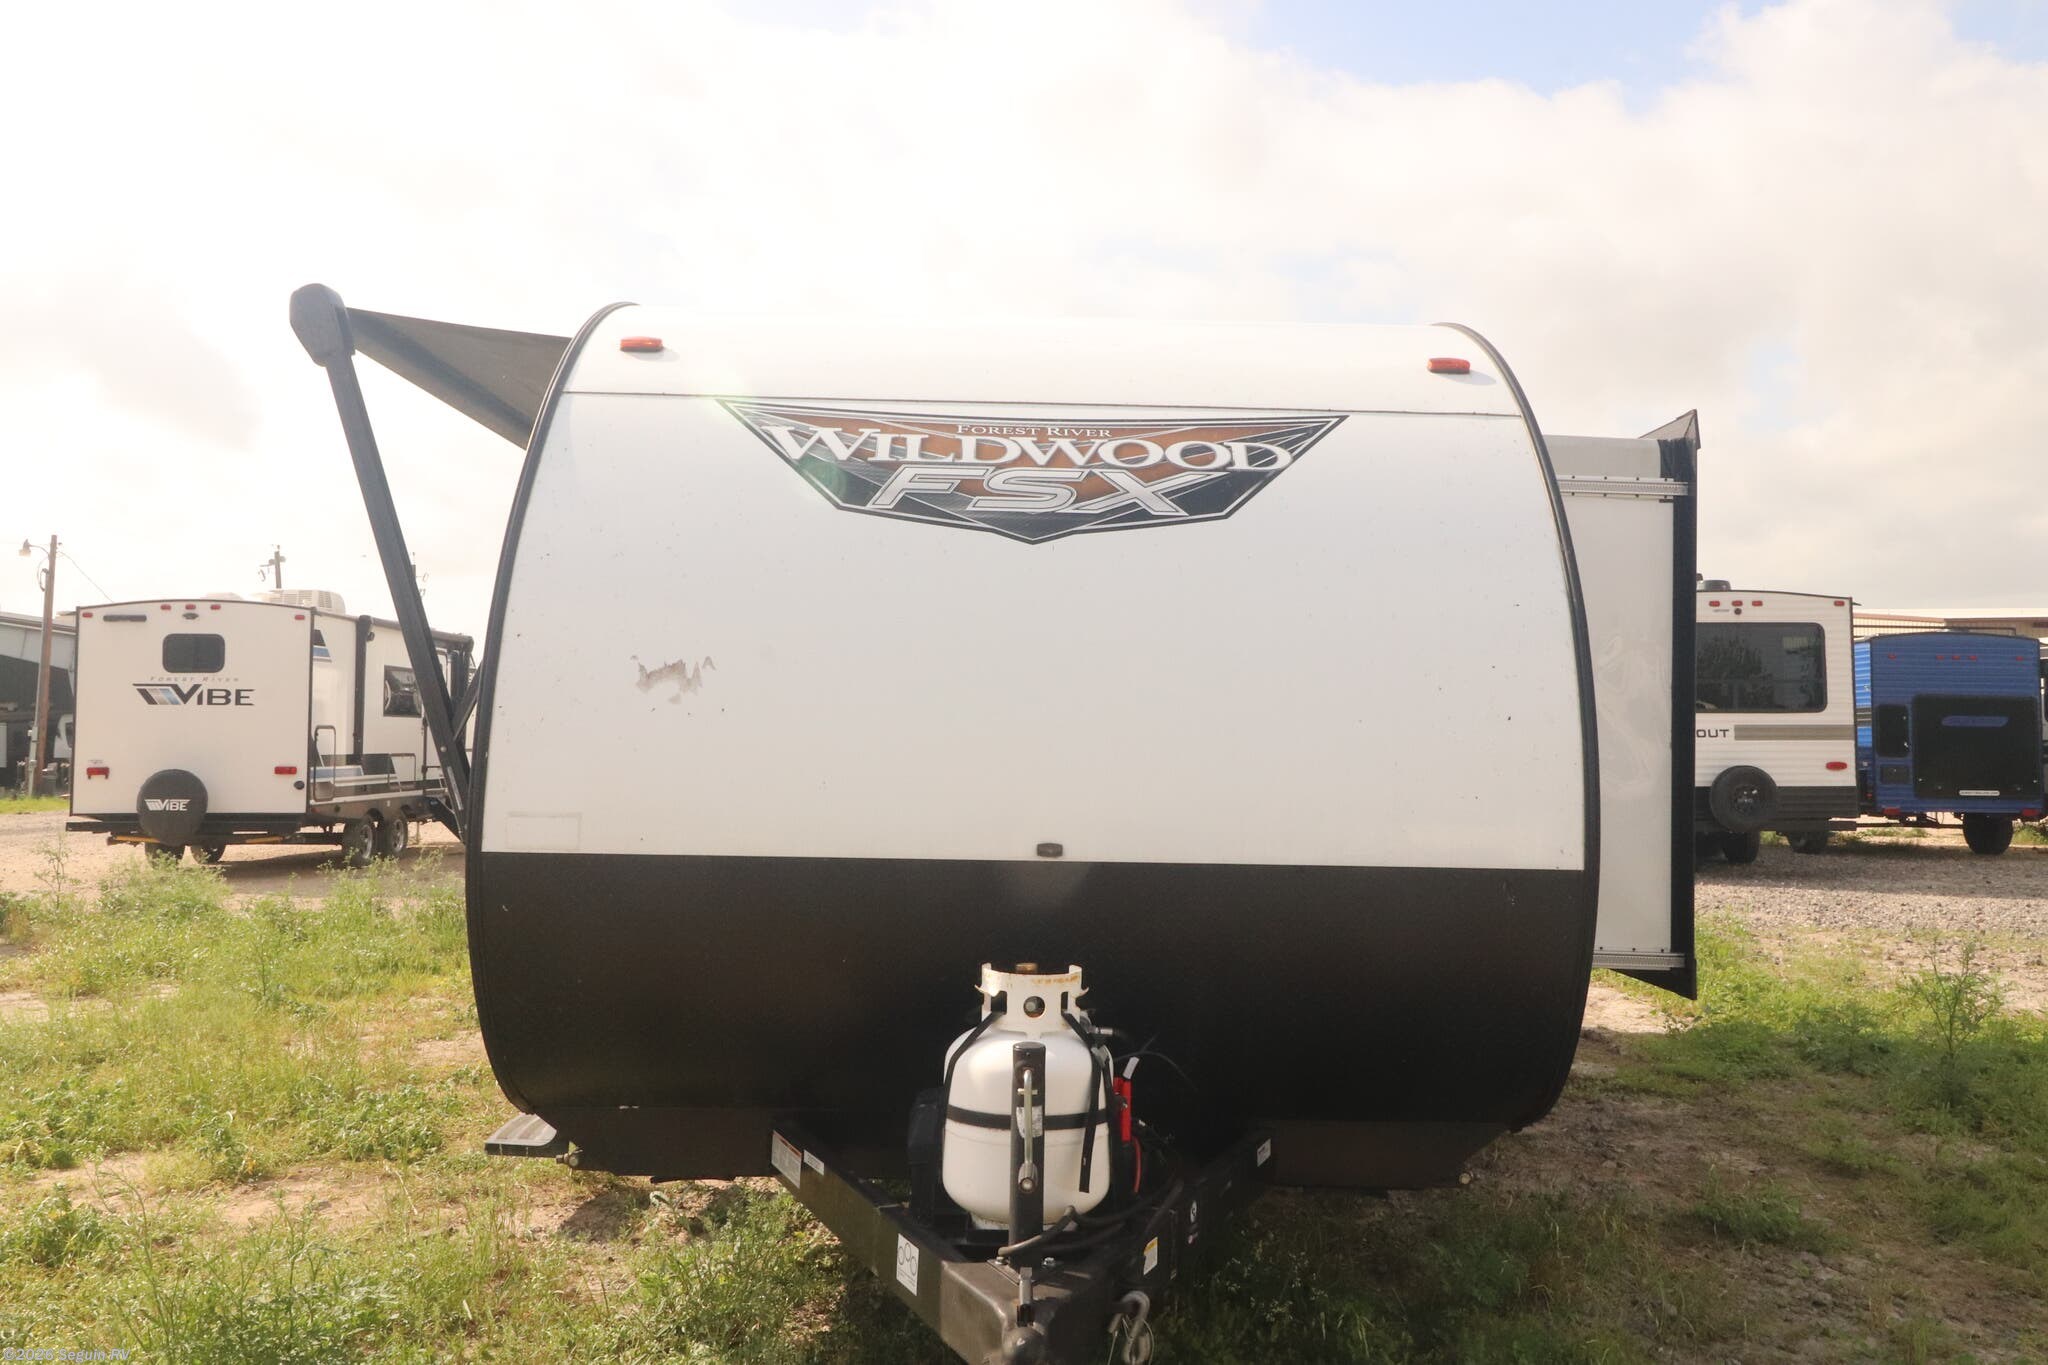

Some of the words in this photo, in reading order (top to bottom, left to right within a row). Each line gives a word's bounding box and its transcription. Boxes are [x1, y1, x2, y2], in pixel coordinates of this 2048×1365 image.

[956, 424, 1041, 436] FOREST
[1047, 427, 1112, 438] RIVER
[759, 425, 1294, 472] WILDWOOD
[867, 465, 1225, 517] FSX
[132, 683, 255, 706] VIBE
[144, 799, 191, 811] VIBE
